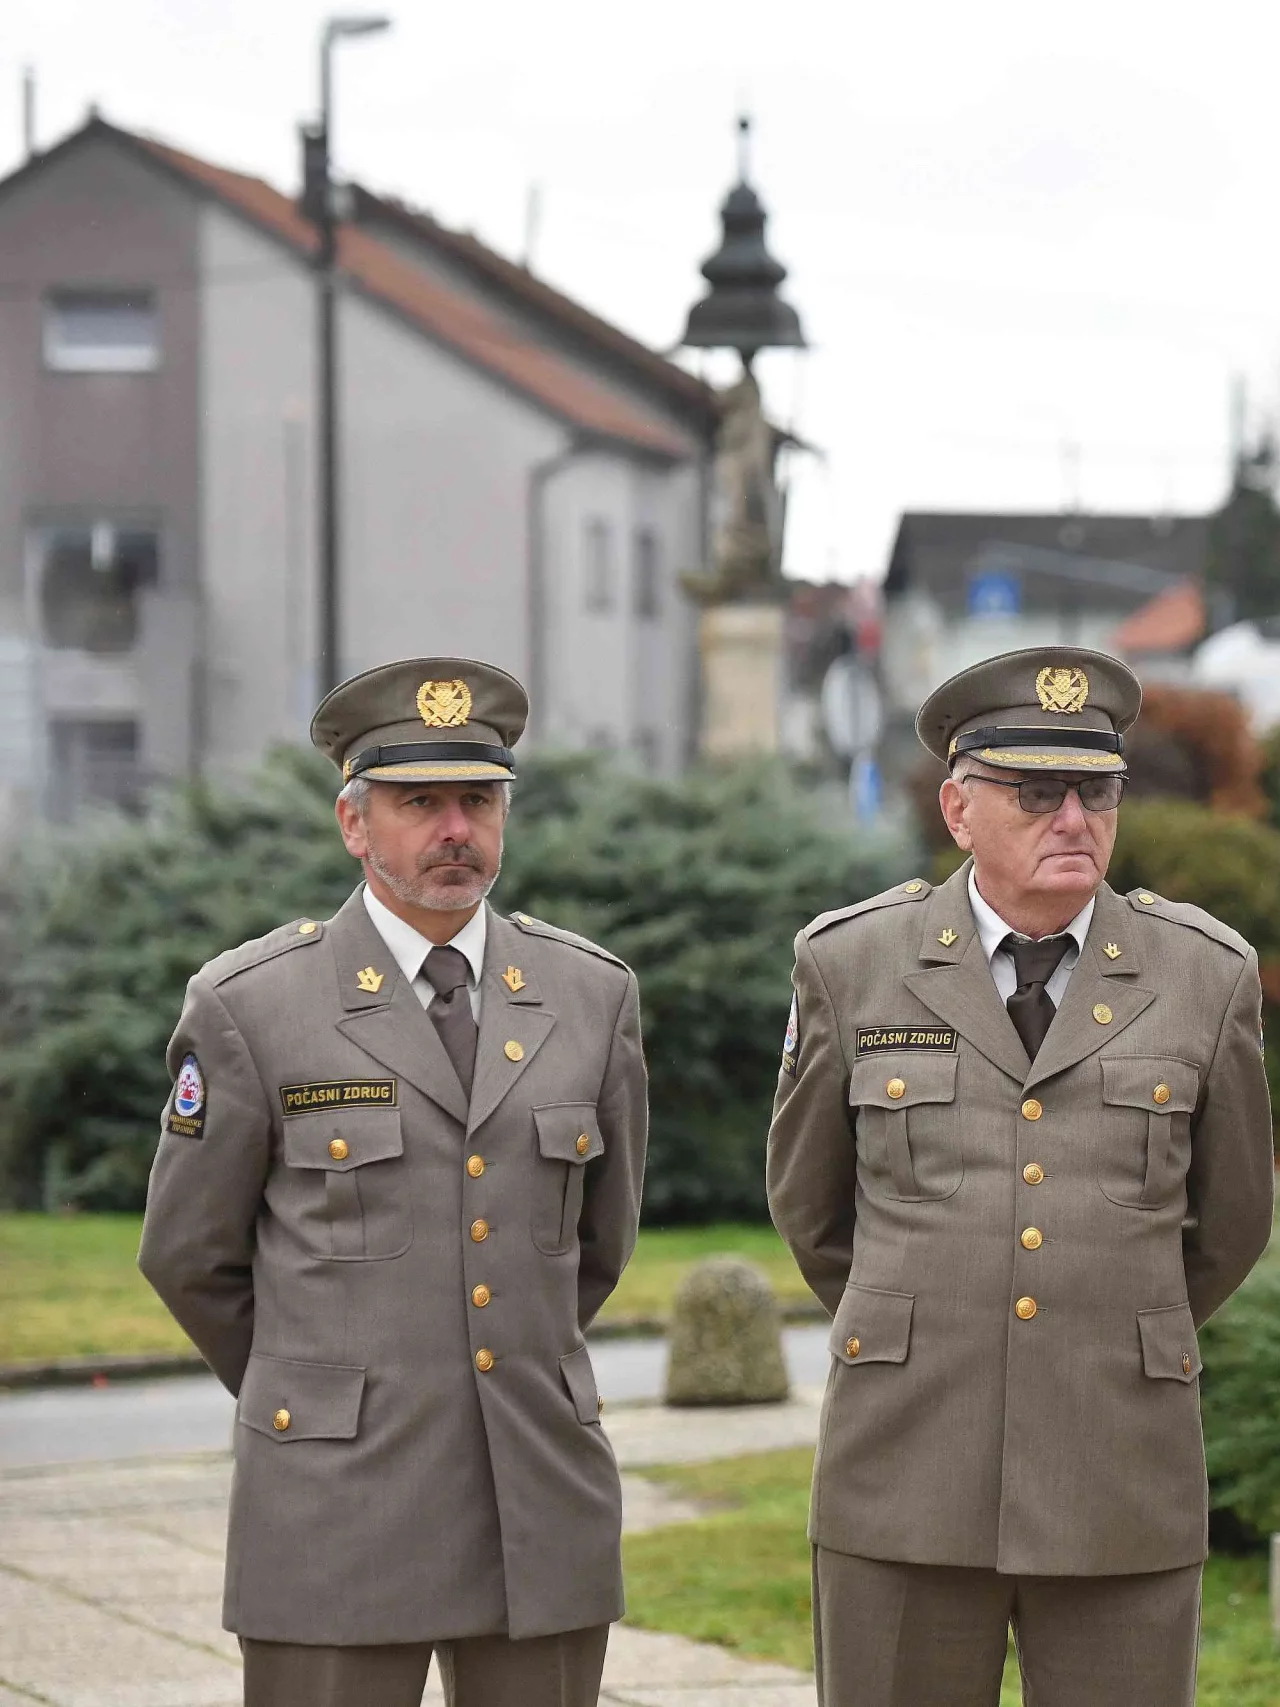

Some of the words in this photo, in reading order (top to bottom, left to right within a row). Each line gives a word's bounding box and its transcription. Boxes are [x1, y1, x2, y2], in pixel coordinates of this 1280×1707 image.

[860, 1030, 907, 1048] POČASNI
[909, 1032, 952, 1045] ZDRUG
[286, 1088, 340, 1107] POČASNI
[343, 1086, 390, 1100] ZDRUG
